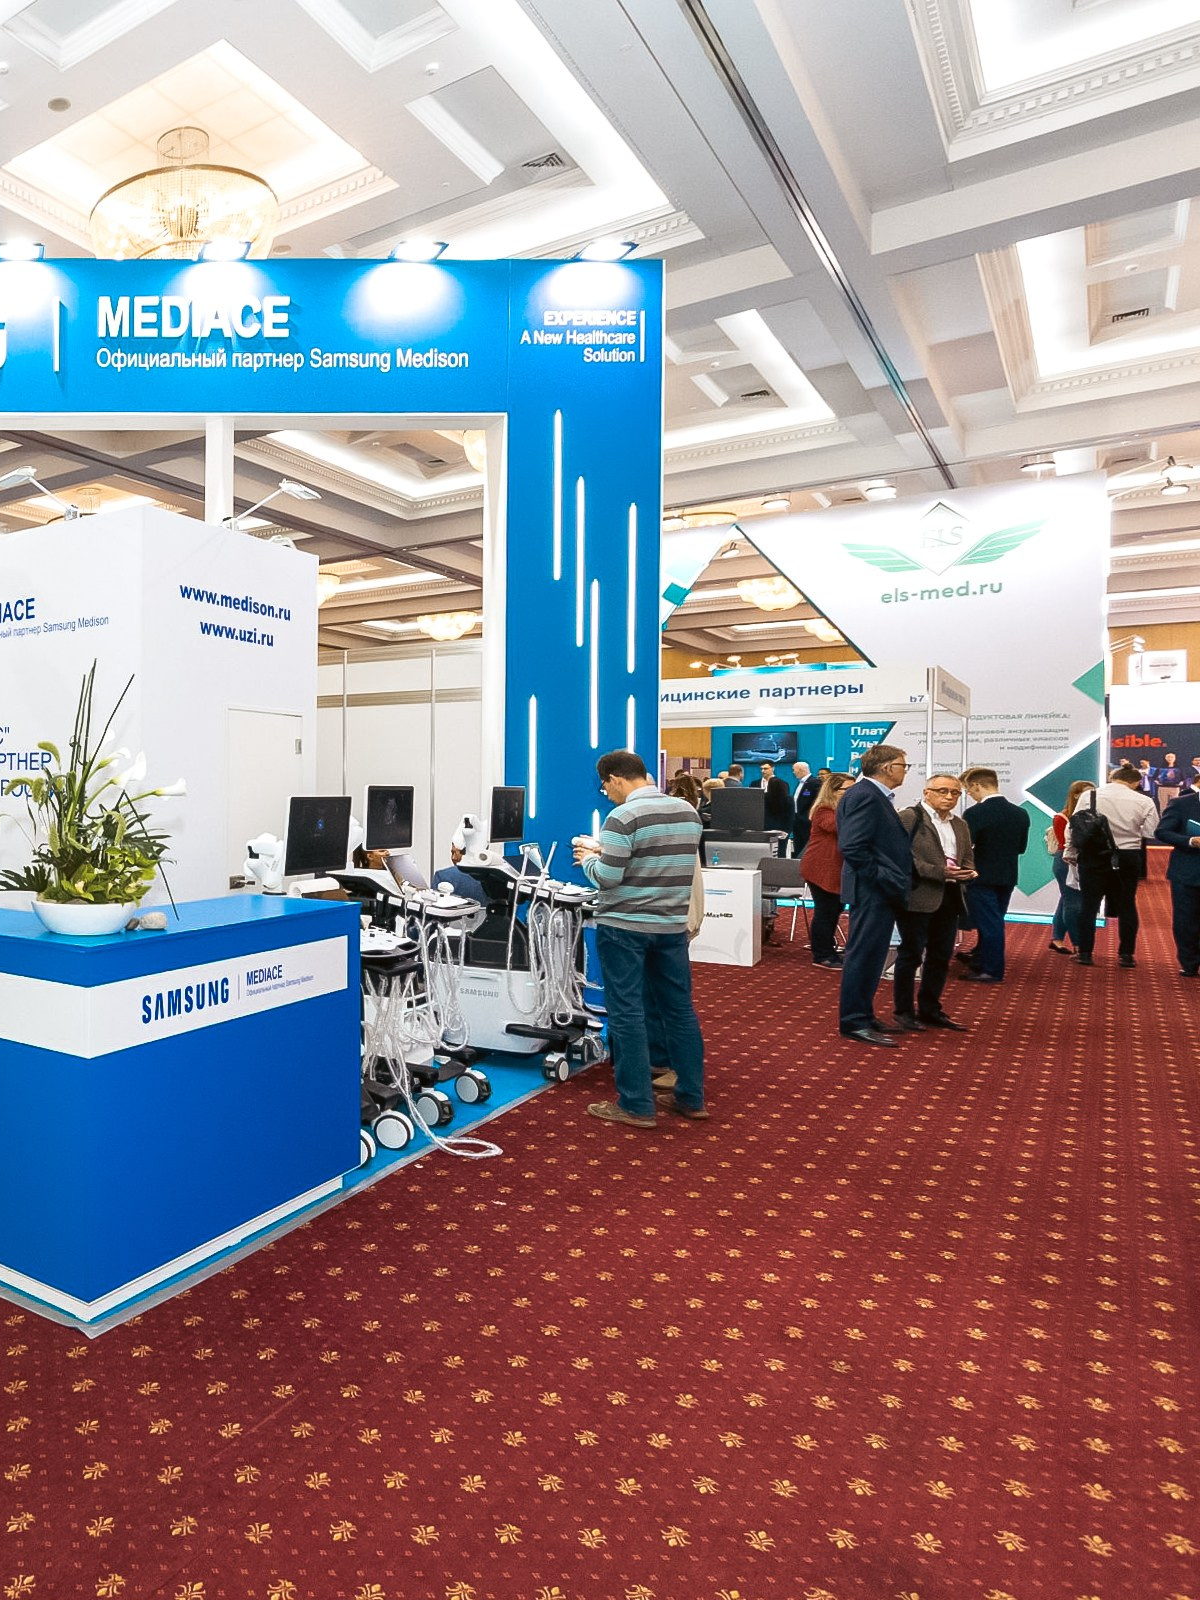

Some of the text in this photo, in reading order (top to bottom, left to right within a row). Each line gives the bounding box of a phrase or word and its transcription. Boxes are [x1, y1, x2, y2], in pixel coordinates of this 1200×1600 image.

[98, 295, 291, 339] MEDIACE
[543, 310, 637, 326] EXPERIENCE
[520, 330, 636, 345] A New Healthcare
[96, 347, 469, 373] Официальный партнер Samsung Medison
[583, 347, 636, 363] Solution
[179, 584, 291, 622] www.medison.ru
[880, 580, 1003, 604] els-med.ru
[43, 620, 76, 633] Samsung
[77, 616, 109, 629] Medison
[200, 621, 274, 647] www.uzi.ru
[660, 682, 864, 704] ицинские партнеры
[850, 726, 888, 736] Плат
[1112, 733, 1168, 748] sible.
[246, 964, 283, 986] MEDIACE
[141, 976, 230, 1025] SAMSUNG
[459, 986, 499, 999] SAMSUNG
